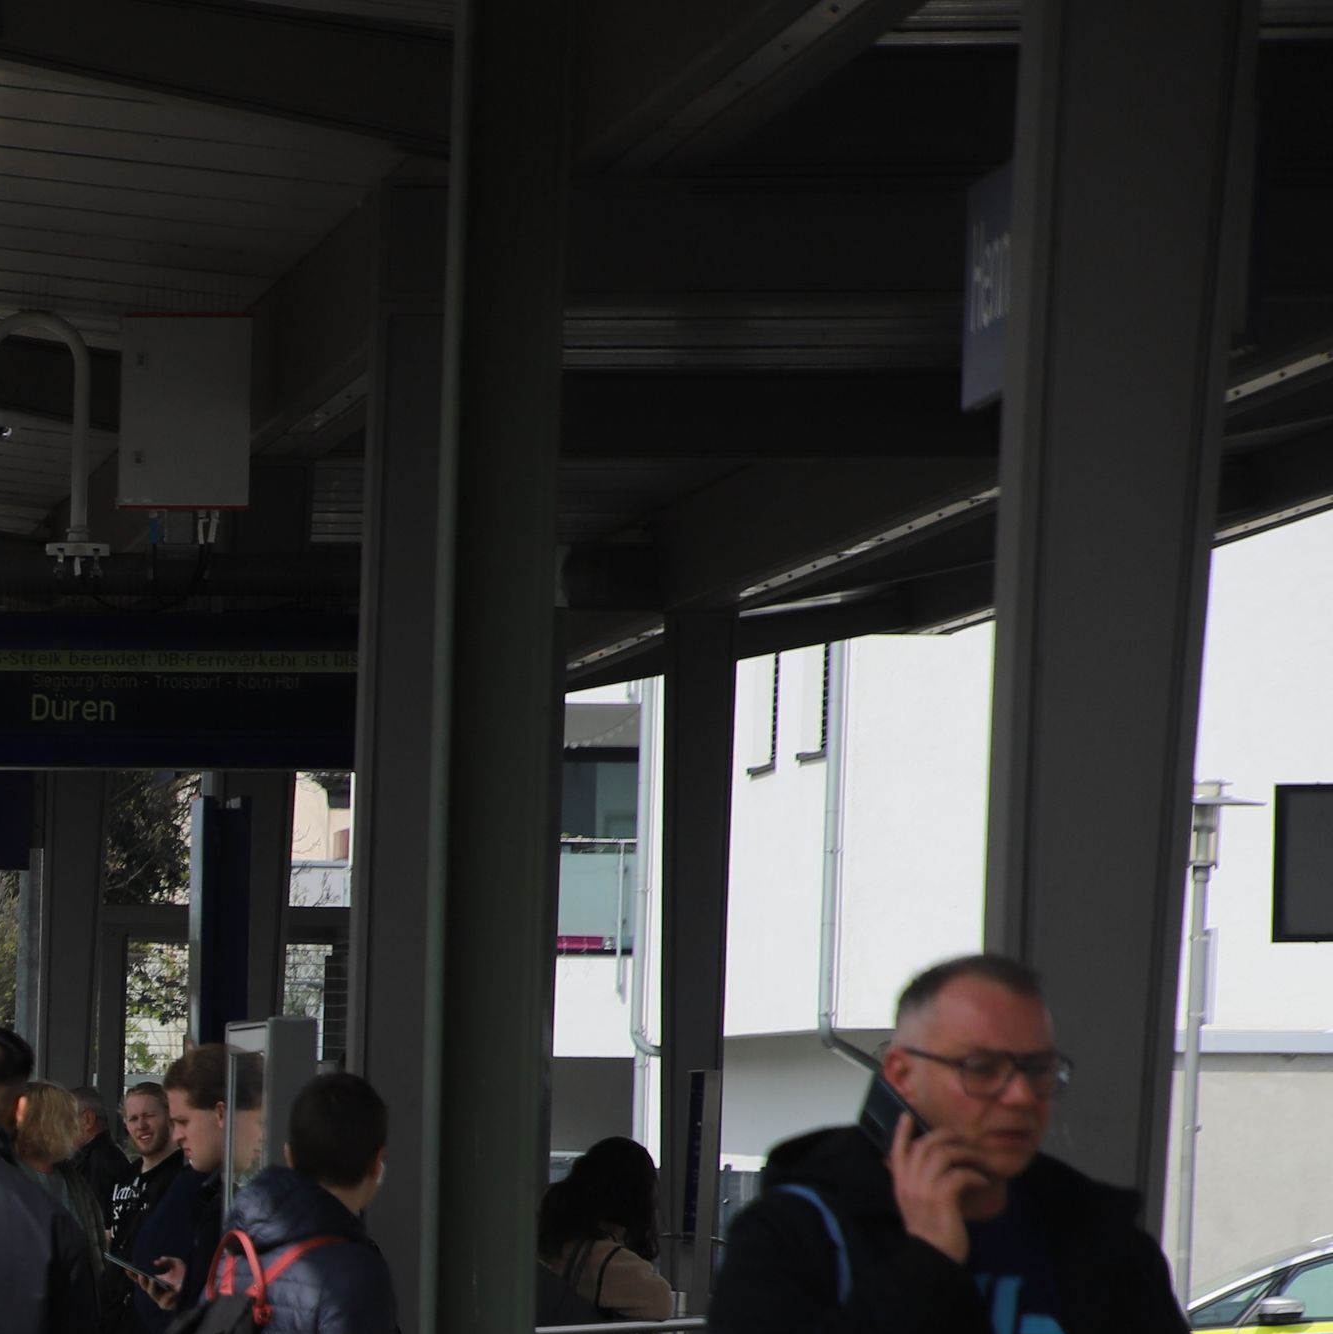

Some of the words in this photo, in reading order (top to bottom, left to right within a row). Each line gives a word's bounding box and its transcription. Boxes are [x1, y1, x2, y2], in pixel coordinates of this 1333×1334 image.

[69, 652, 151, 667] beendet:
[157, 652, 297, 667] DB-Fernverkehr
[304, 653, 327, 667] ist
[32, 673, 138, 692] Siegburg/Bonn
[154, 674, 222, 689] Troisdorf
[237, 673, 272, 689] Köln
[275, 674, 301, 689] Hbf
[31, 693, 116, 721] Düren
